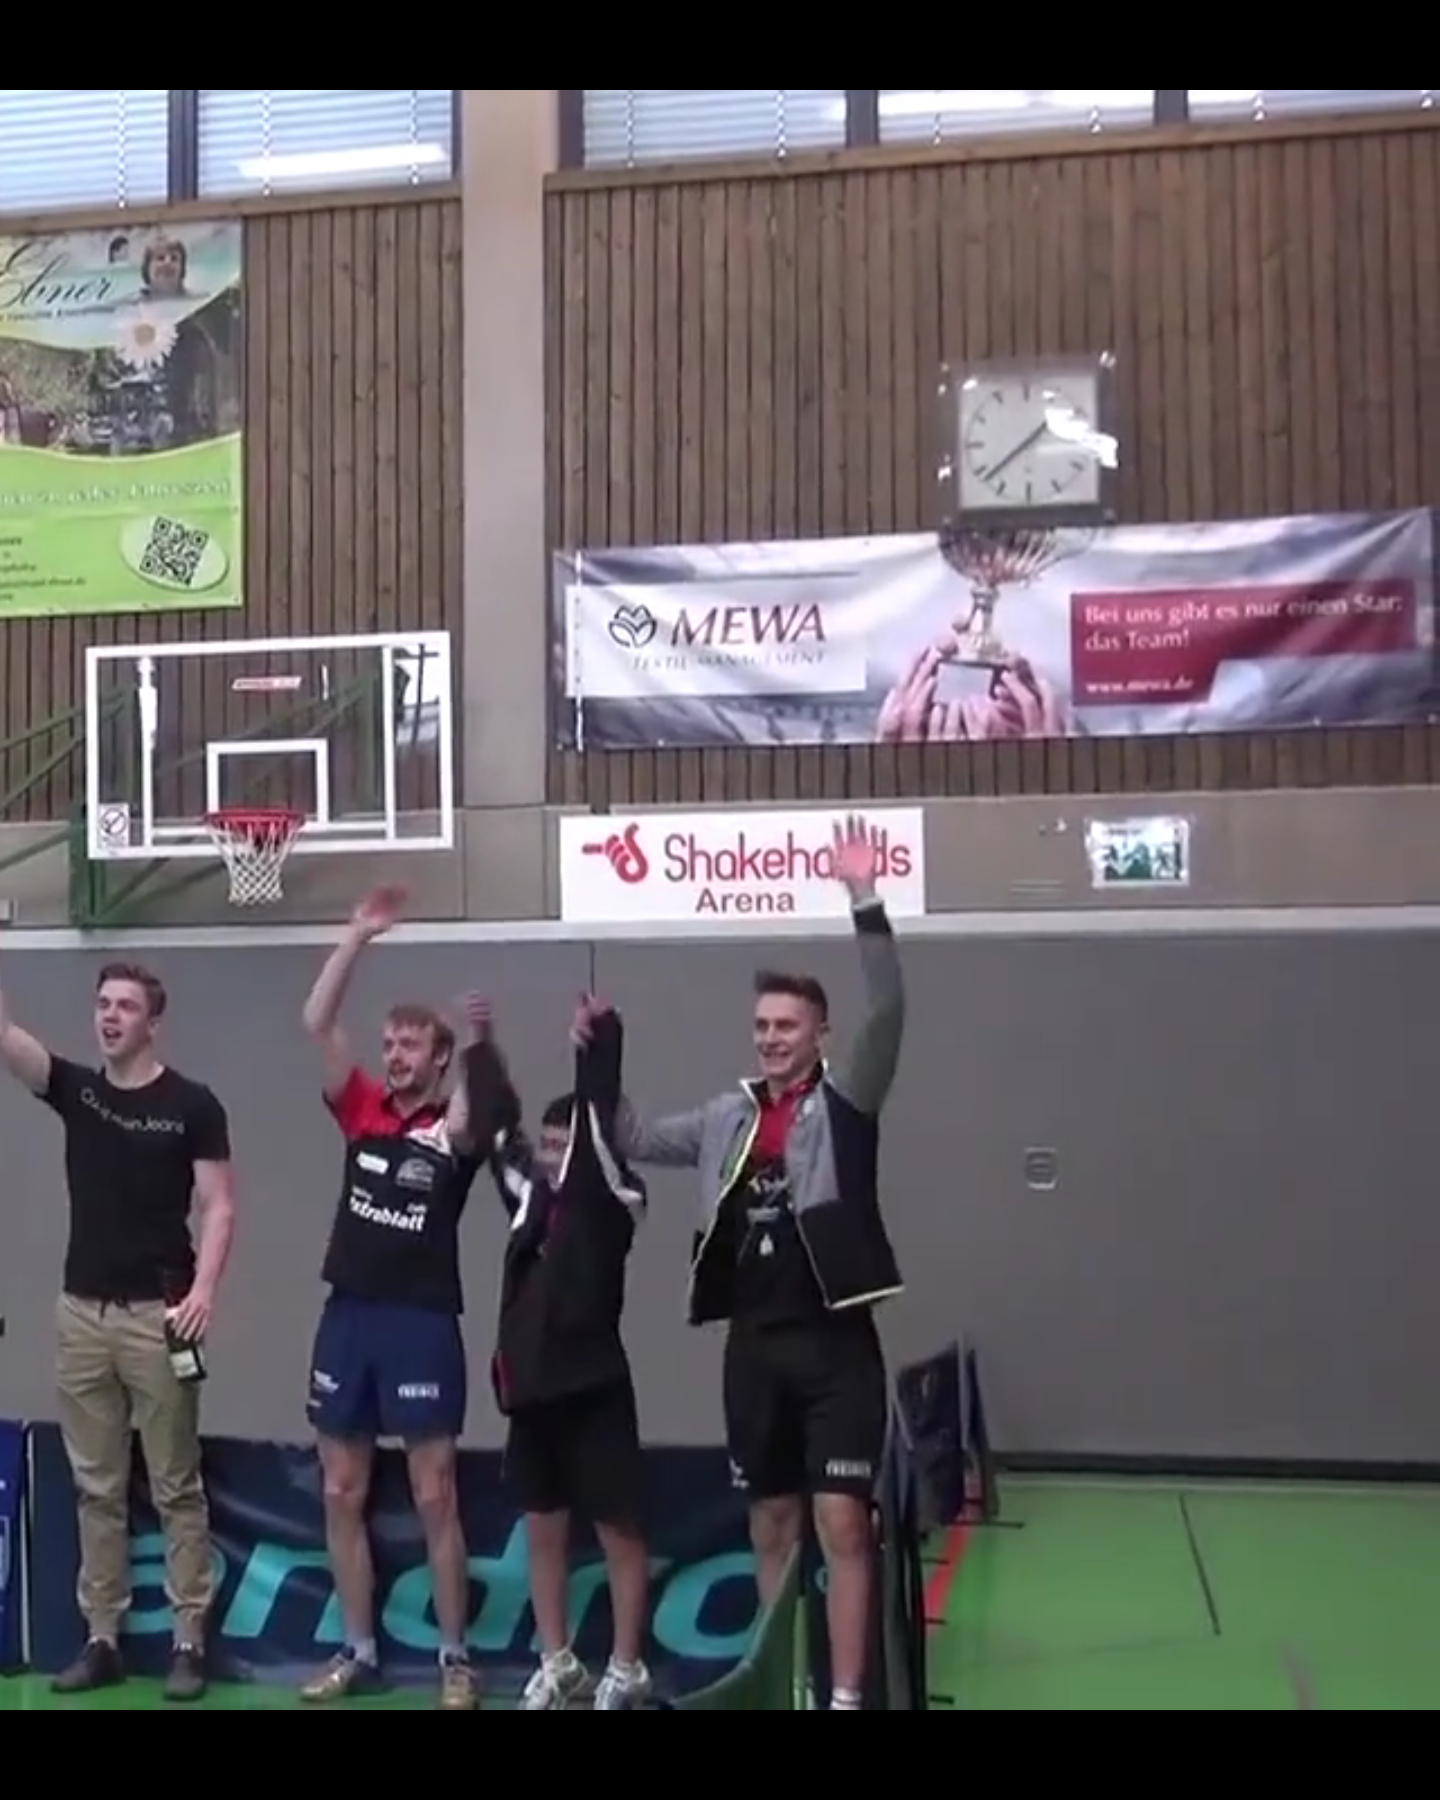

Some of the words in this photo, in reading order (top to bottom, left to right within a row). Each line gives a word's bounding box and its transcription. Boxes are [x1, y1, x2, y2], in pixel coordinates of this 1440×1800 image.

[671, 604, 825, 646] MEWA
[1085, 605, 1119, 624] Bei
[1126, 606, 1161, 623] uns
[1168, 602, 1209, 625] gibt
[1216, 604, 1238, 619] es
[1245, 602, 1279, 617] nur
[1287, 600, 1348, 616] einen
[1085, 632, 1120, 651] das
[1127, 628, 1189, 650] Team!
[664, 828, 912, 883] Shakehads
[695, 888, 796, 914] Arena
